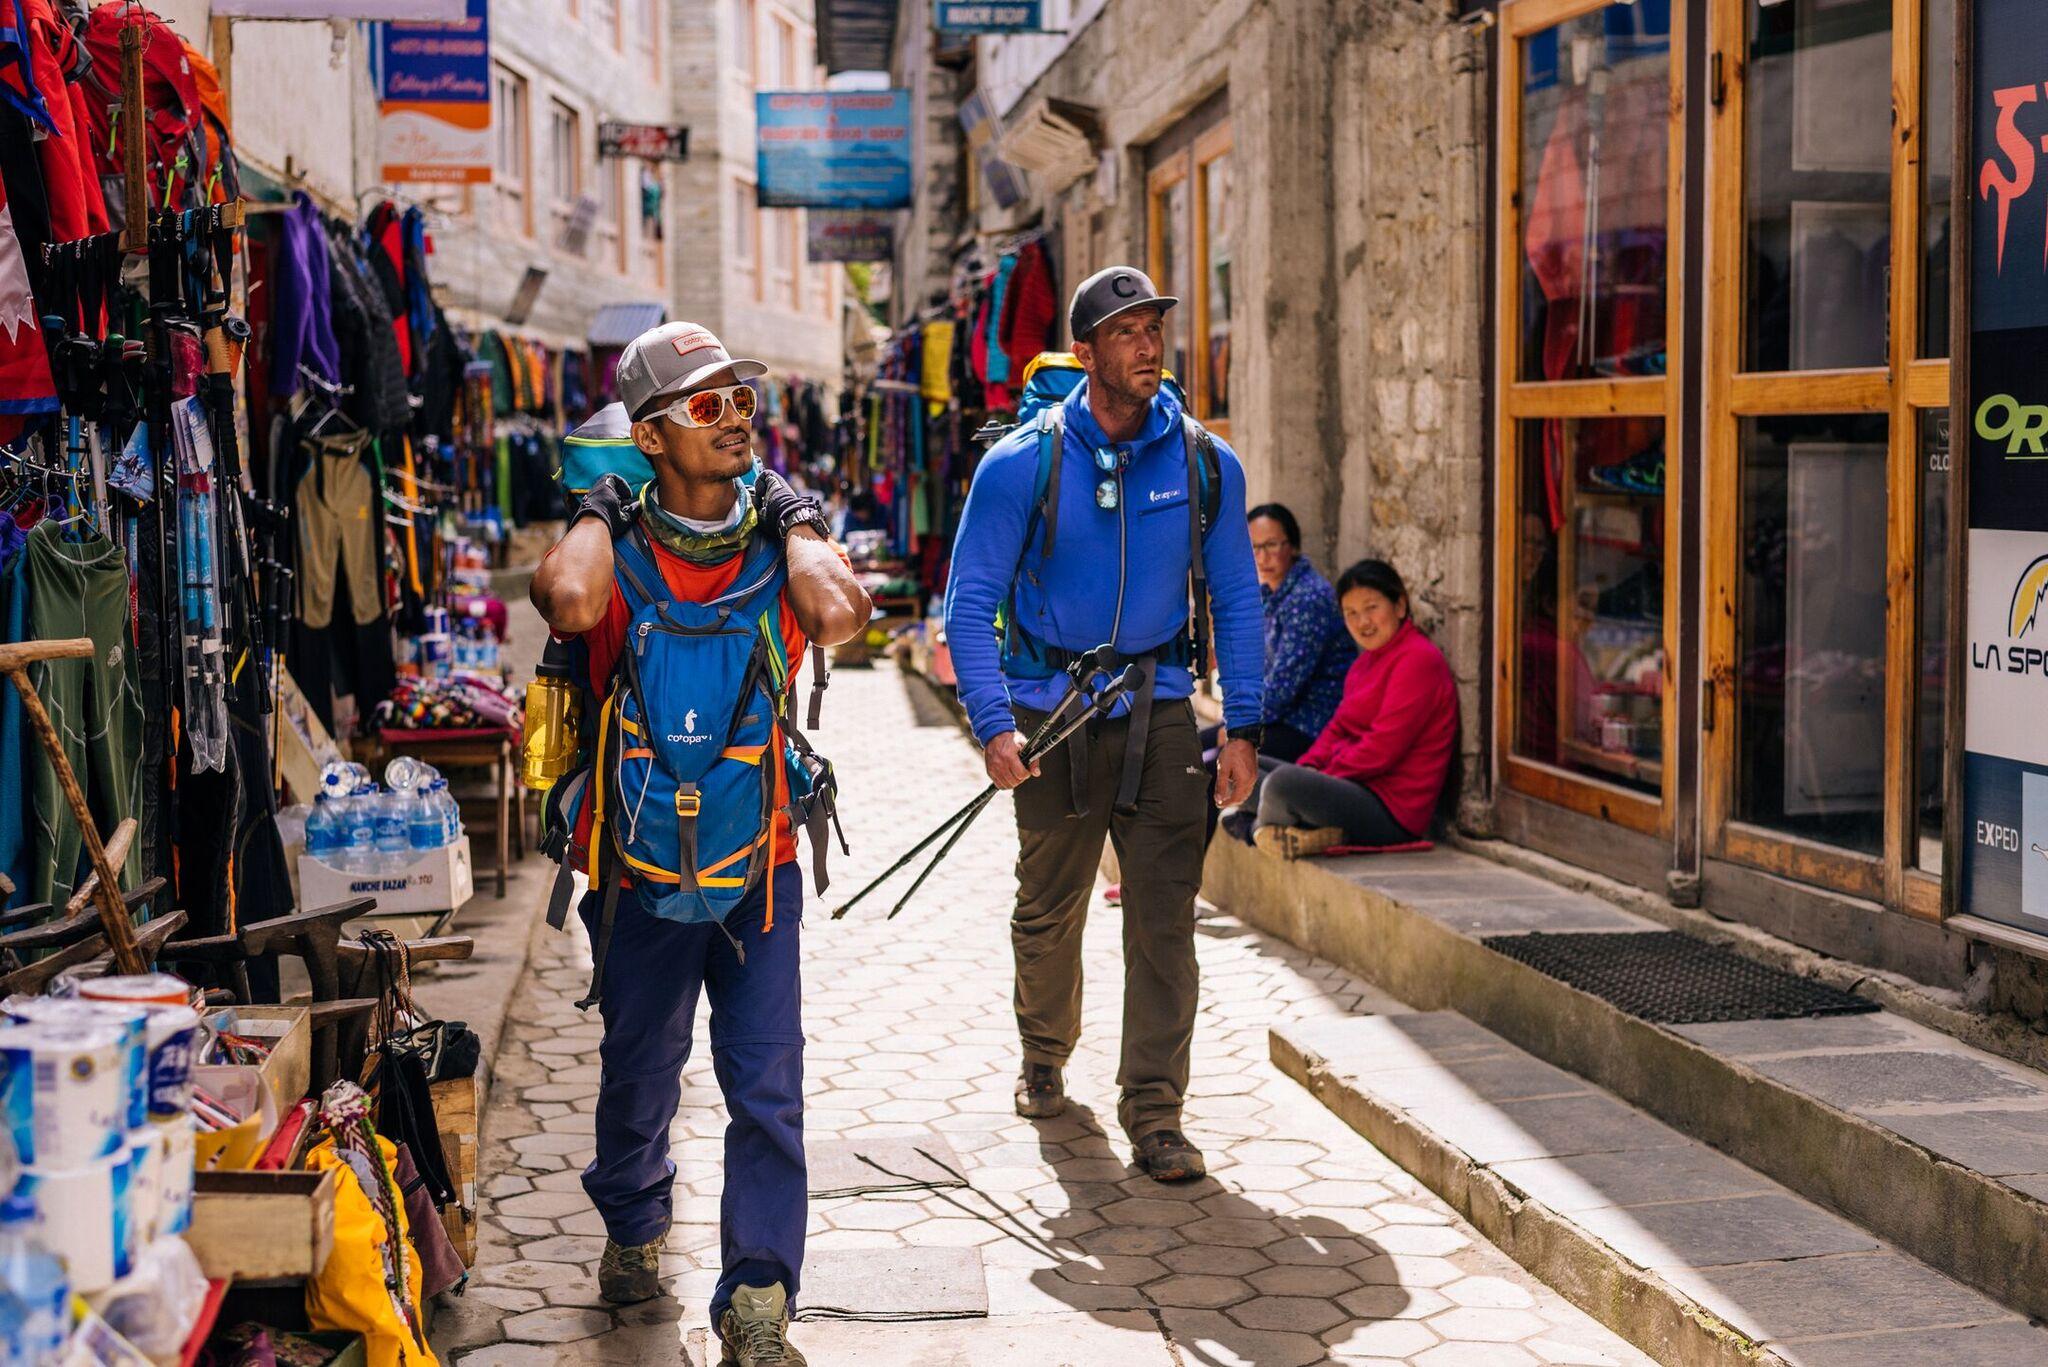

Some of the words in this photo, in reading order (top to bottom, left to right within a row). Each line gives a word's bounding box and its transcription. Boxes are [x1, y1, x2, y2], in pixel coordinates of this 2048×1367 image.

[1112, 274, 1137, 298] C
[1975, 393, 2048, 453] OR
[1973, 642, 2001, 671] LA
[1977, 820, 2019, 853] EXPED
[383, 878, 407, 891] BAZAR
